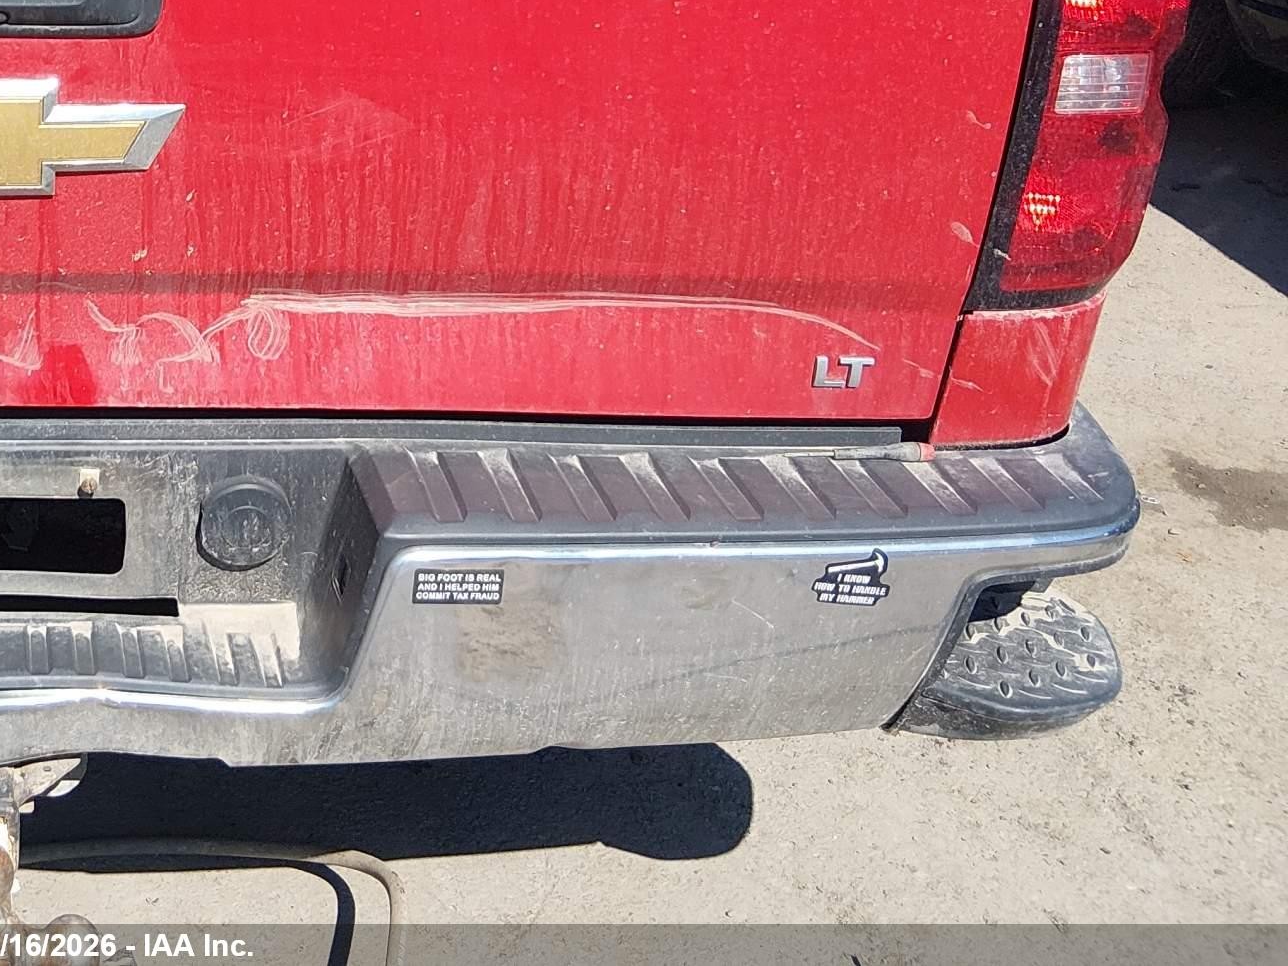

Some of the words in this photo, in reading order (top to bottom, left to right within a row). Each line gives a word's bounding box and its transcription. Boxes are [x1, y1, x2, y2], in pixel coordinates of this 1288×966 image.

[811, 355, 875, 389] LT
[418, 573, 436, 582] BIG
[437, 573, 464, 582] FOOT
[465, 573, 475, 582] IS
[476, 573, 502, 582] REAL
[837, 574, 843, 582] I
[843, 574, 871, 584] KNOW
[417, 583, 438, 592] AND
[444, 583, 481, 592] HELPED
[482, 583, 500, 592] HIM
[814, 582, 836, 591] HOW
[838, 584, 851, 593] TO
[852, 585, 887, 596] HANDLE
[415, 592, 451, 600] COMMIT
[452, 592, 470, 600] TAX
[470, 592, 500, 600] FRAUD
[819, 592, 836, 602] MY
[836, 594, 875, 605] HAMMER
